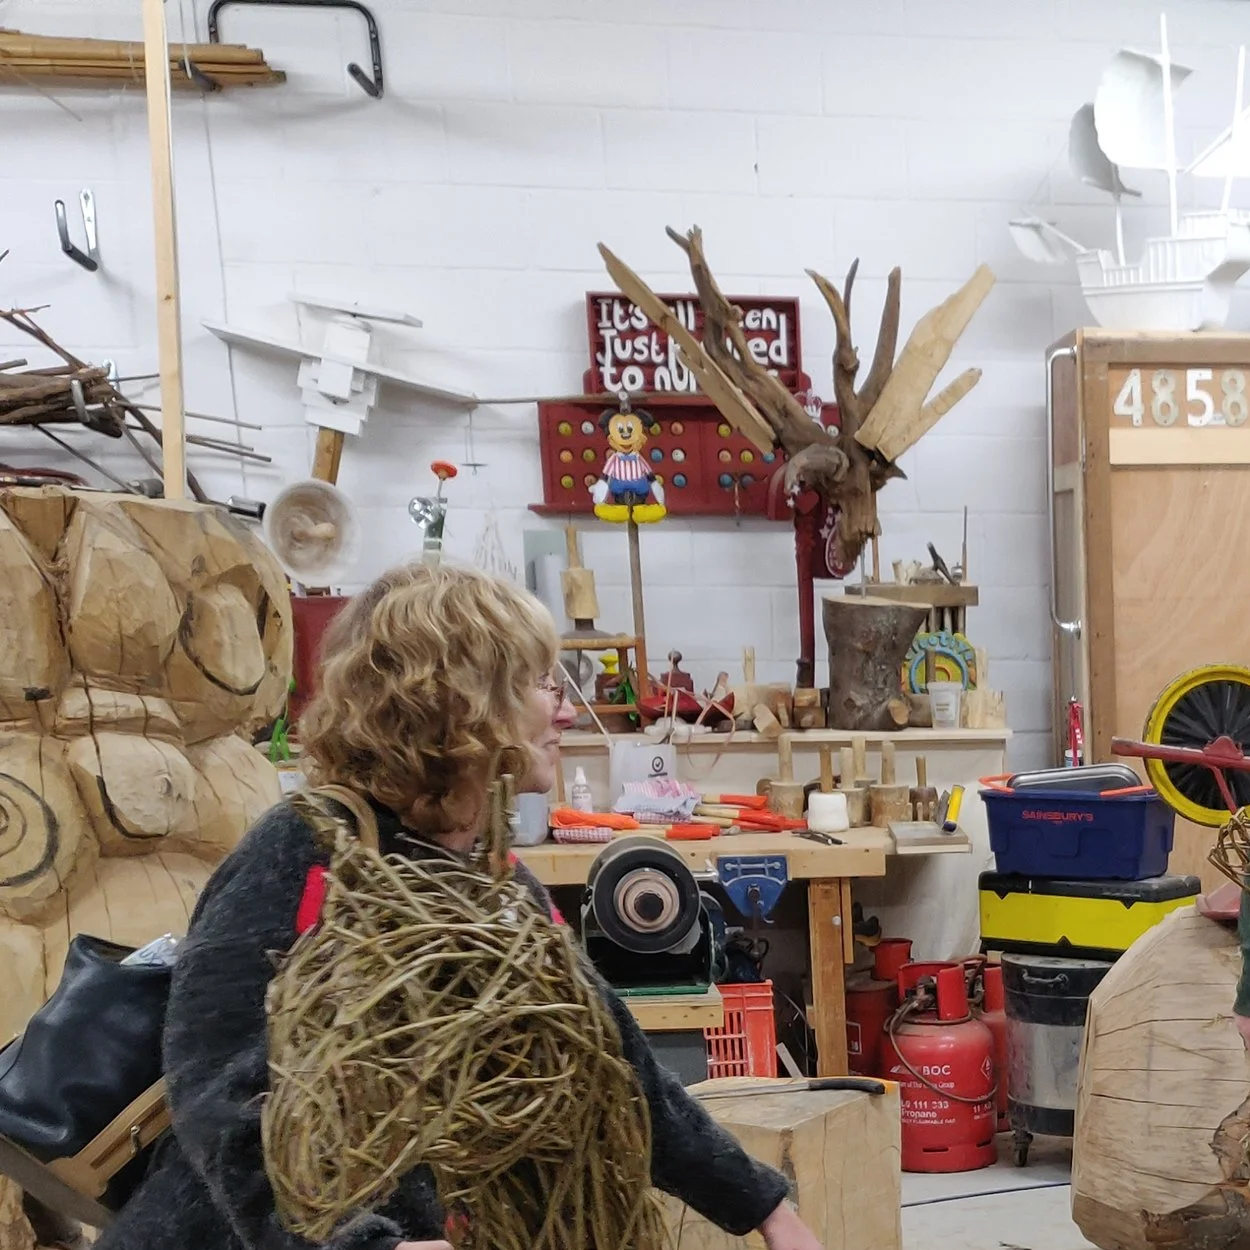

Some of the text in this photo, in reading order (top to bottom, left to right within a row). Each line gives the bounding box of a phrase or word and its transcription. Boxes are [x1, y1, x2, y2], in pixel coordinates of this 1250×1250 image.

[596, 328, 665, 367] Just
[600, 365, 645, 392] to
[1022, 810, 1094, 822] SAINSBURY'S
[922, 1065, 951, 1076] BOC
